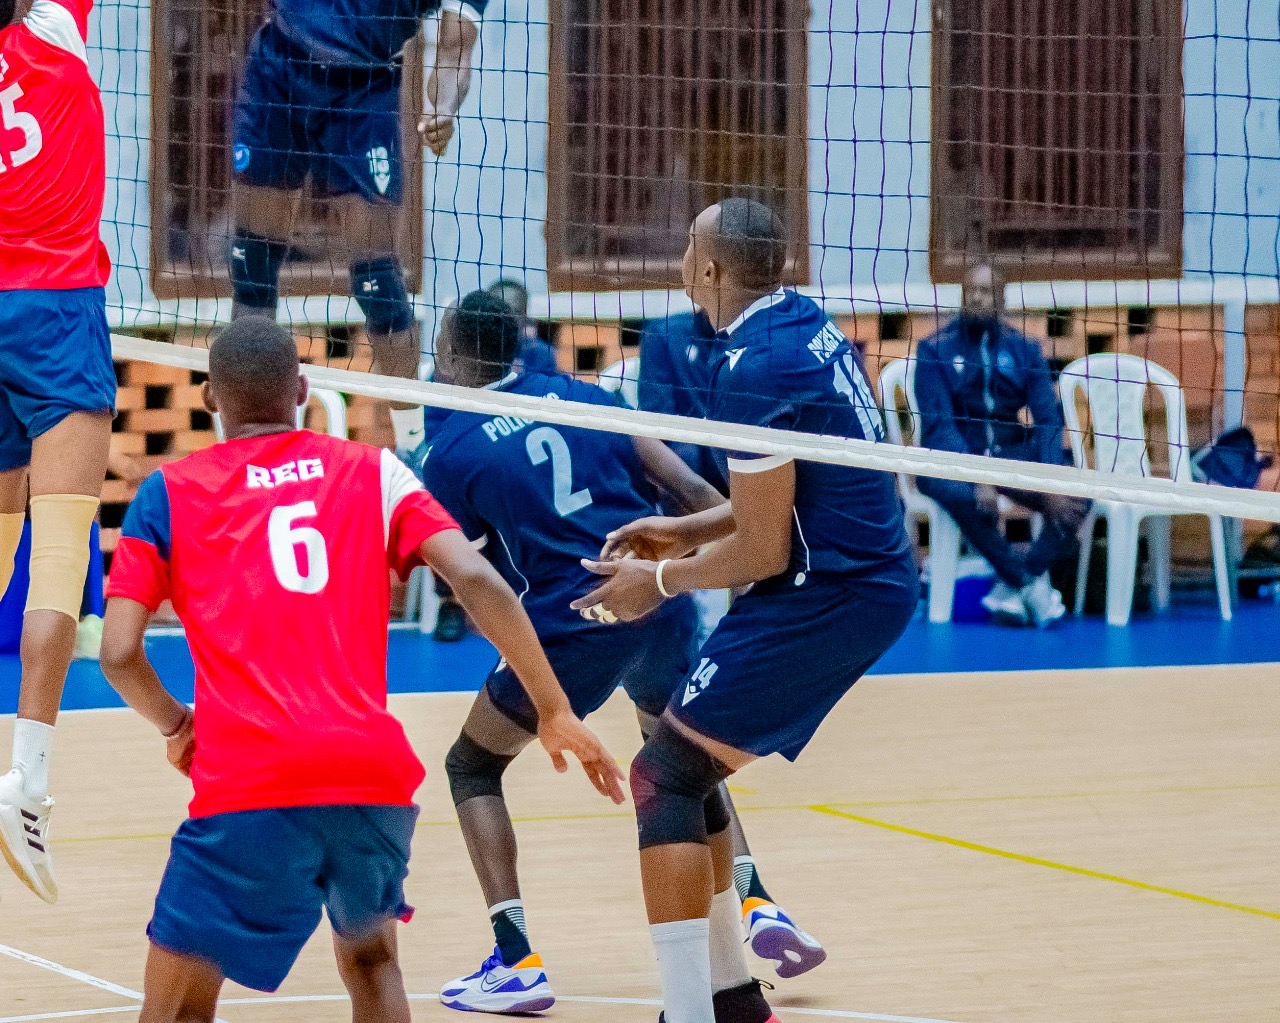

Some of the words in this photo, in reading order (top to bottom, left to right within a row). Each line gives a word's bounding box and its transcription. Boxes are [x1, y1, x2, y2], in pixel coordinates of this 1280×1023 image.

[807, 327, 839, 364] POLICE
[246, 457, 325, 489] REG
[525, 426, 593, 517] 2
[267, 500, 330, 595] 6
[691, 657, 719, 690] 14
